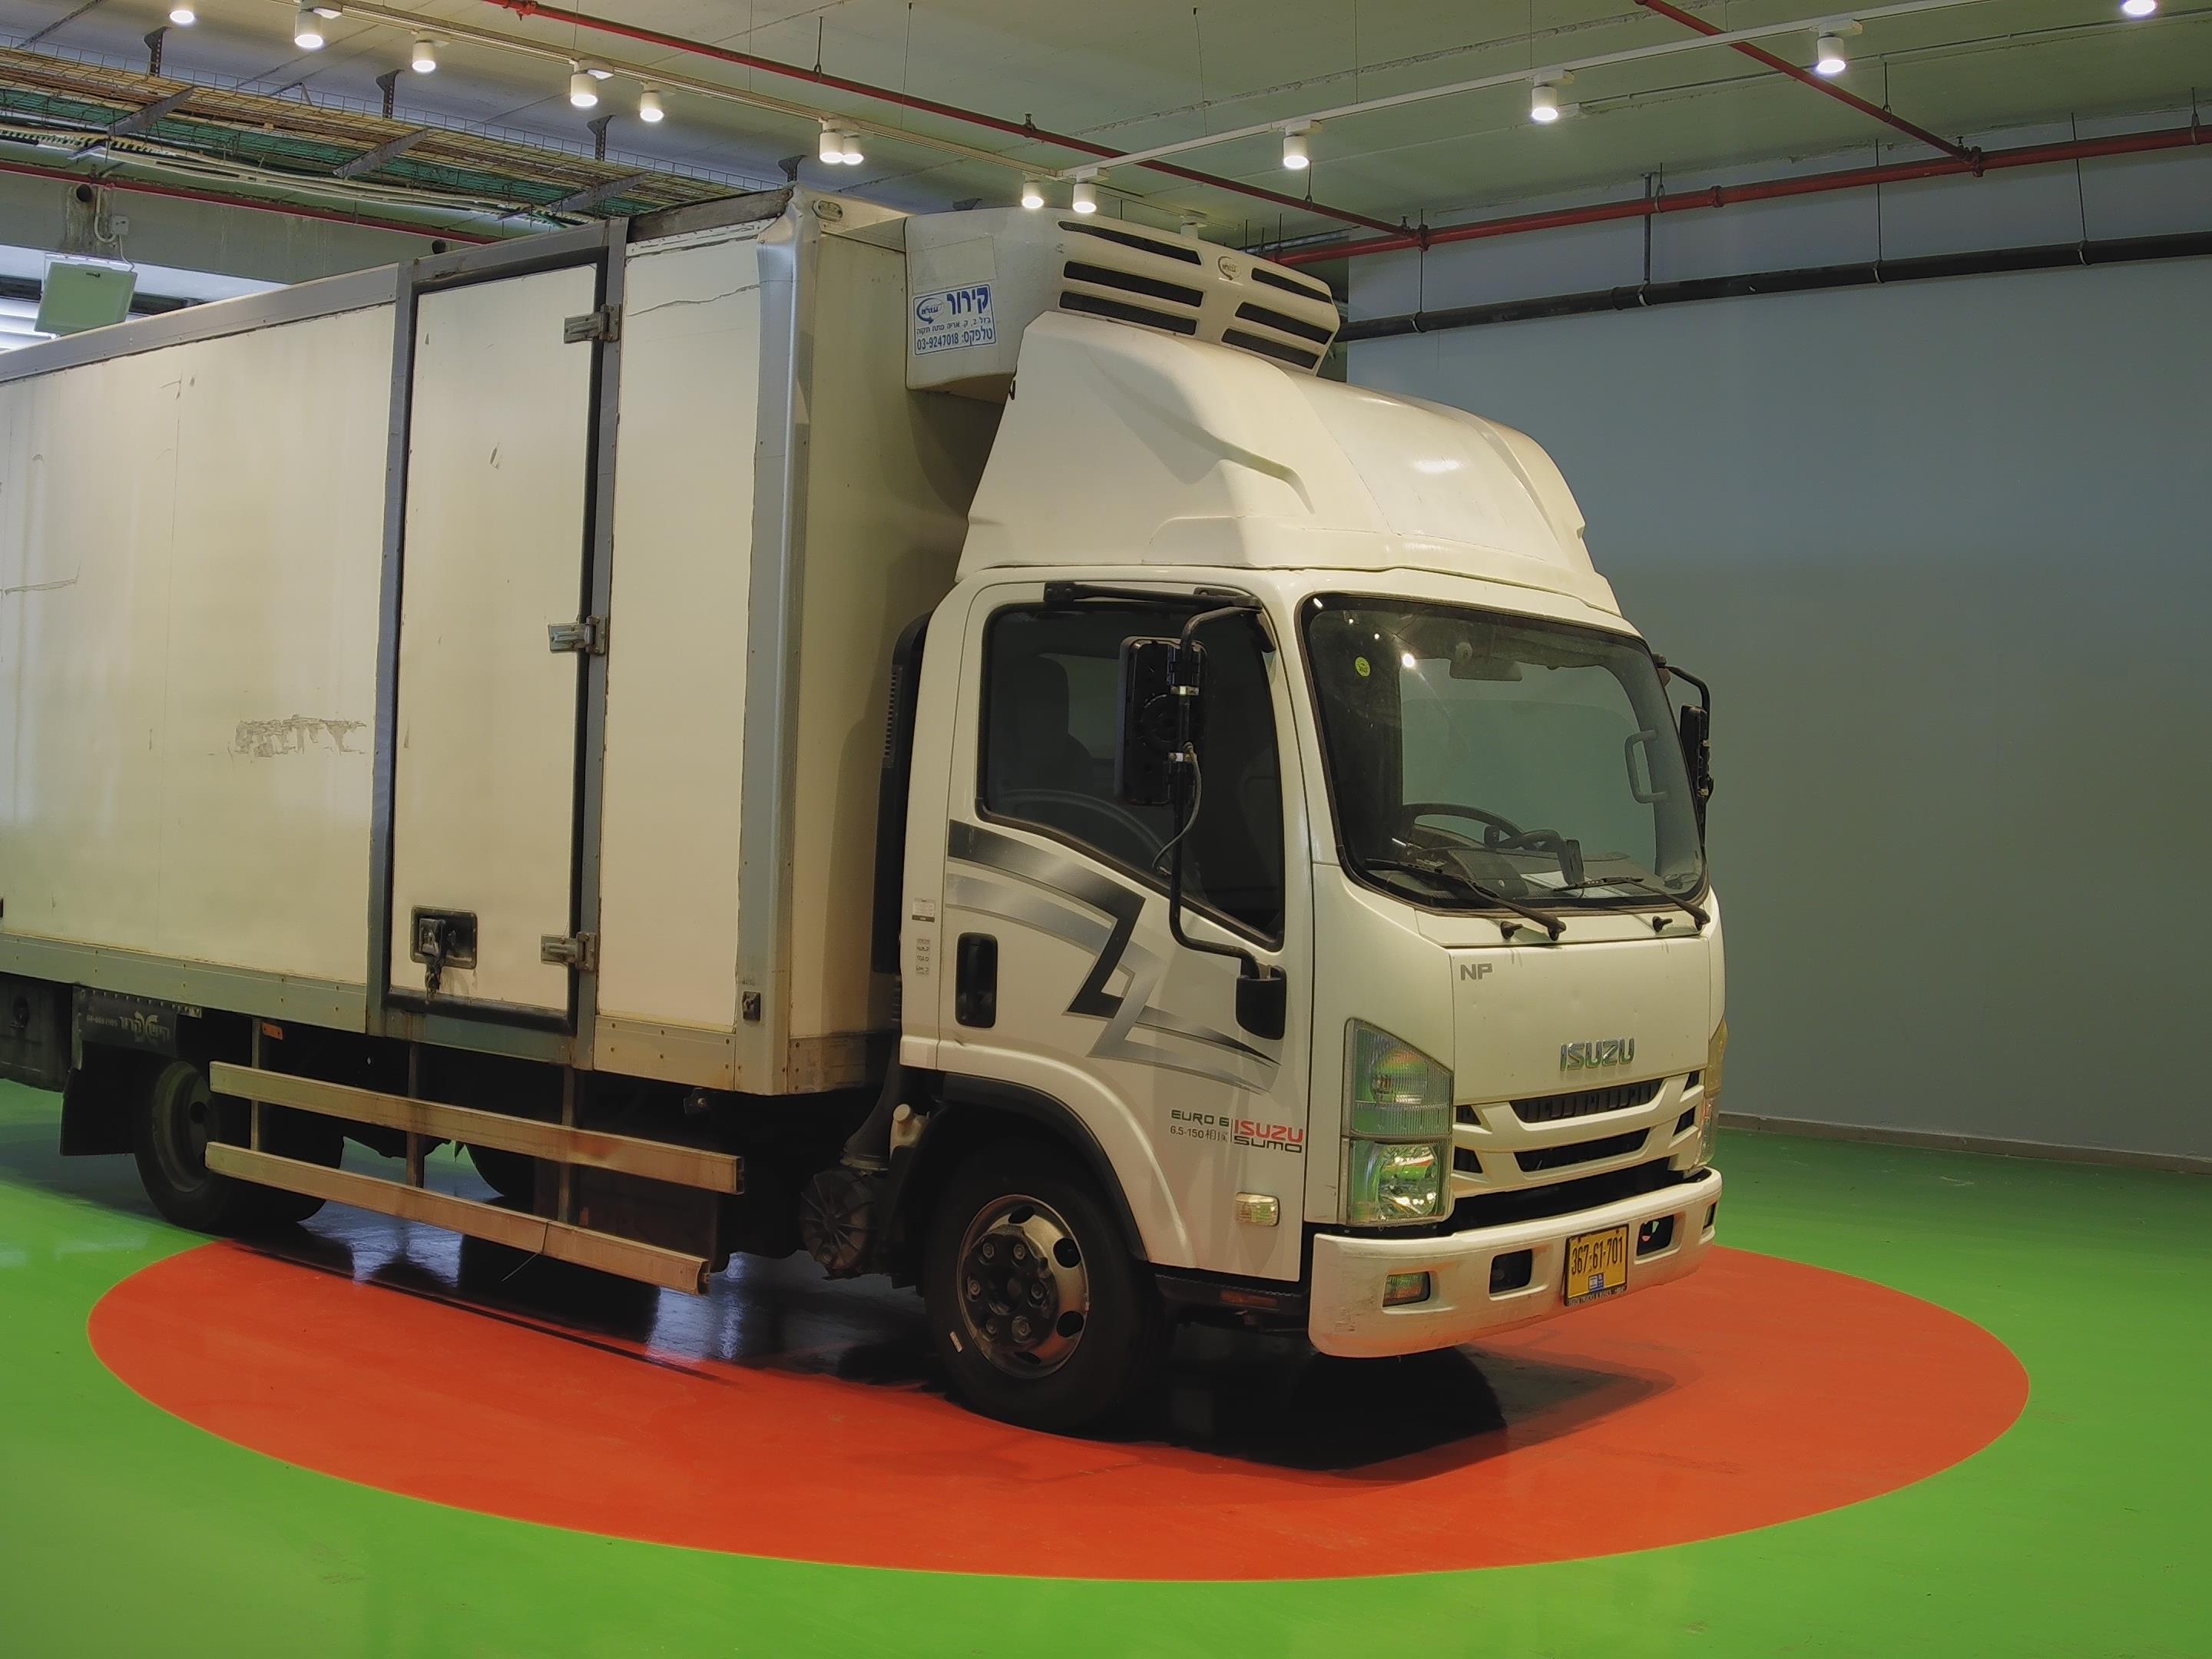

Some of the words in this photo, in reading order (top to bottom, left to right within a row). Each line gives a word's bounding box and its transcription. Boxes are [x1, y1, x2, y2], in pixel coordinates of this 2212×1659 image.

[946, 286, 988, 315] קירור
[917, 333, 959, 350] 03-9247018
[962, 326, 993, 345] טלפקס:
[1460, 962, 1493, 981] NP
[1560, 1038, 1635, 1072] ISUZU
[1171, 1109, 1214, 1125] EURO
[1219, 1117, 1230, 1127] 6
[1170, 1125, 1204, 1139] 6.5-150
[1234, 1119, 1303, 1143] ISUZU
[1233, 1135, 1303, 1153] SUMO
[1571, 1236, 1623, 1276] 367-61-701
